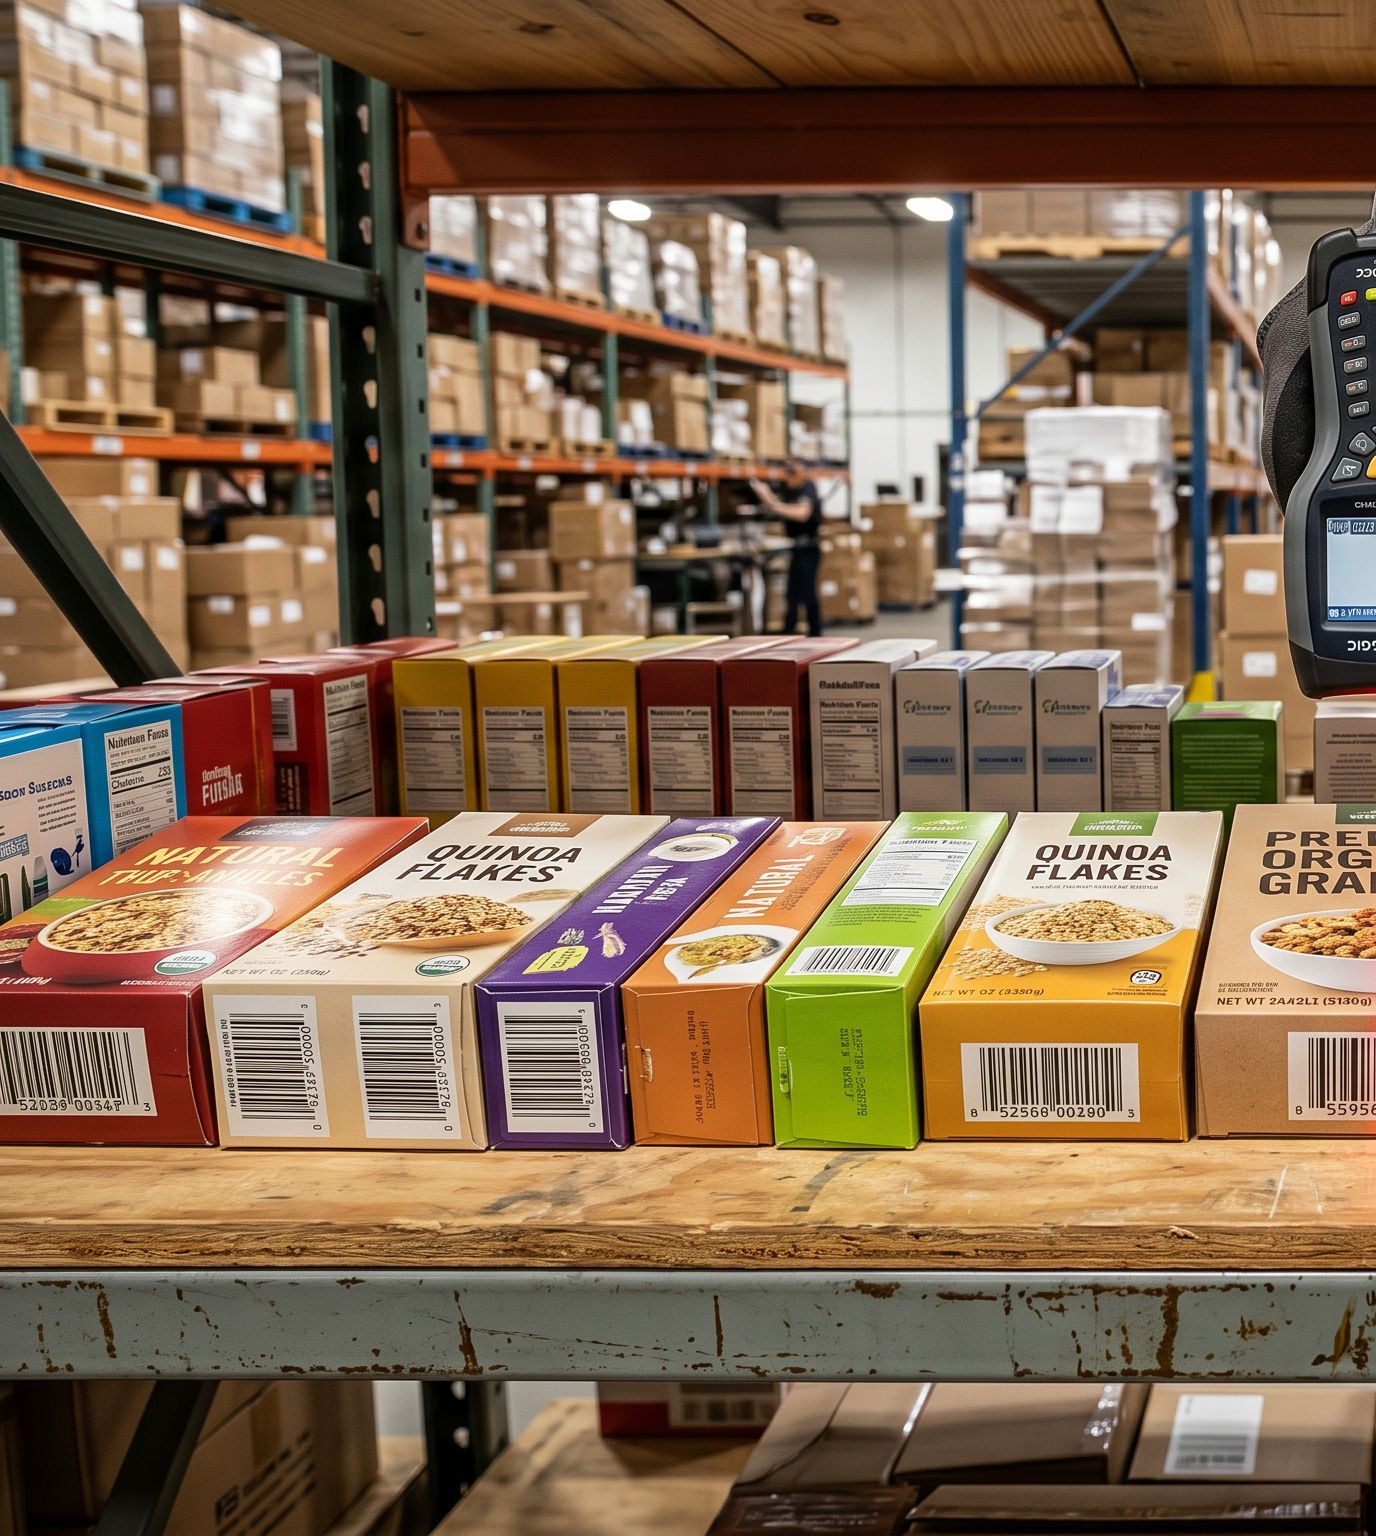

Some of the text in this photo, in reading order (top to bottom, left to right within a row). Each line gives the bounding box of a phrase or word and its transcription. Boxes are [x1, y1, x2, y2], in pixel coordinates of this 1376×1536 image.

[134, 845, 346, 868] NATURAL
[427, 844, 583, 863] QUINOA
[1035, 844, 1173, 862] QUINOA
[394, 863, 564, 883] FLAKES
[1025, 864, 1170, 881] FLAKES
[723, 854, 815, 919] NATURAL
[1216, 997, 1242, 1006] NET
[1245, 997, 1266, 1006] WT
[143, 1102, 151, 1112] 3
[970, 1109, 978, 1118] 8
[1127, 1109, 1135, 1118] 3
[1295, 1105, 1303, 1115] 8
